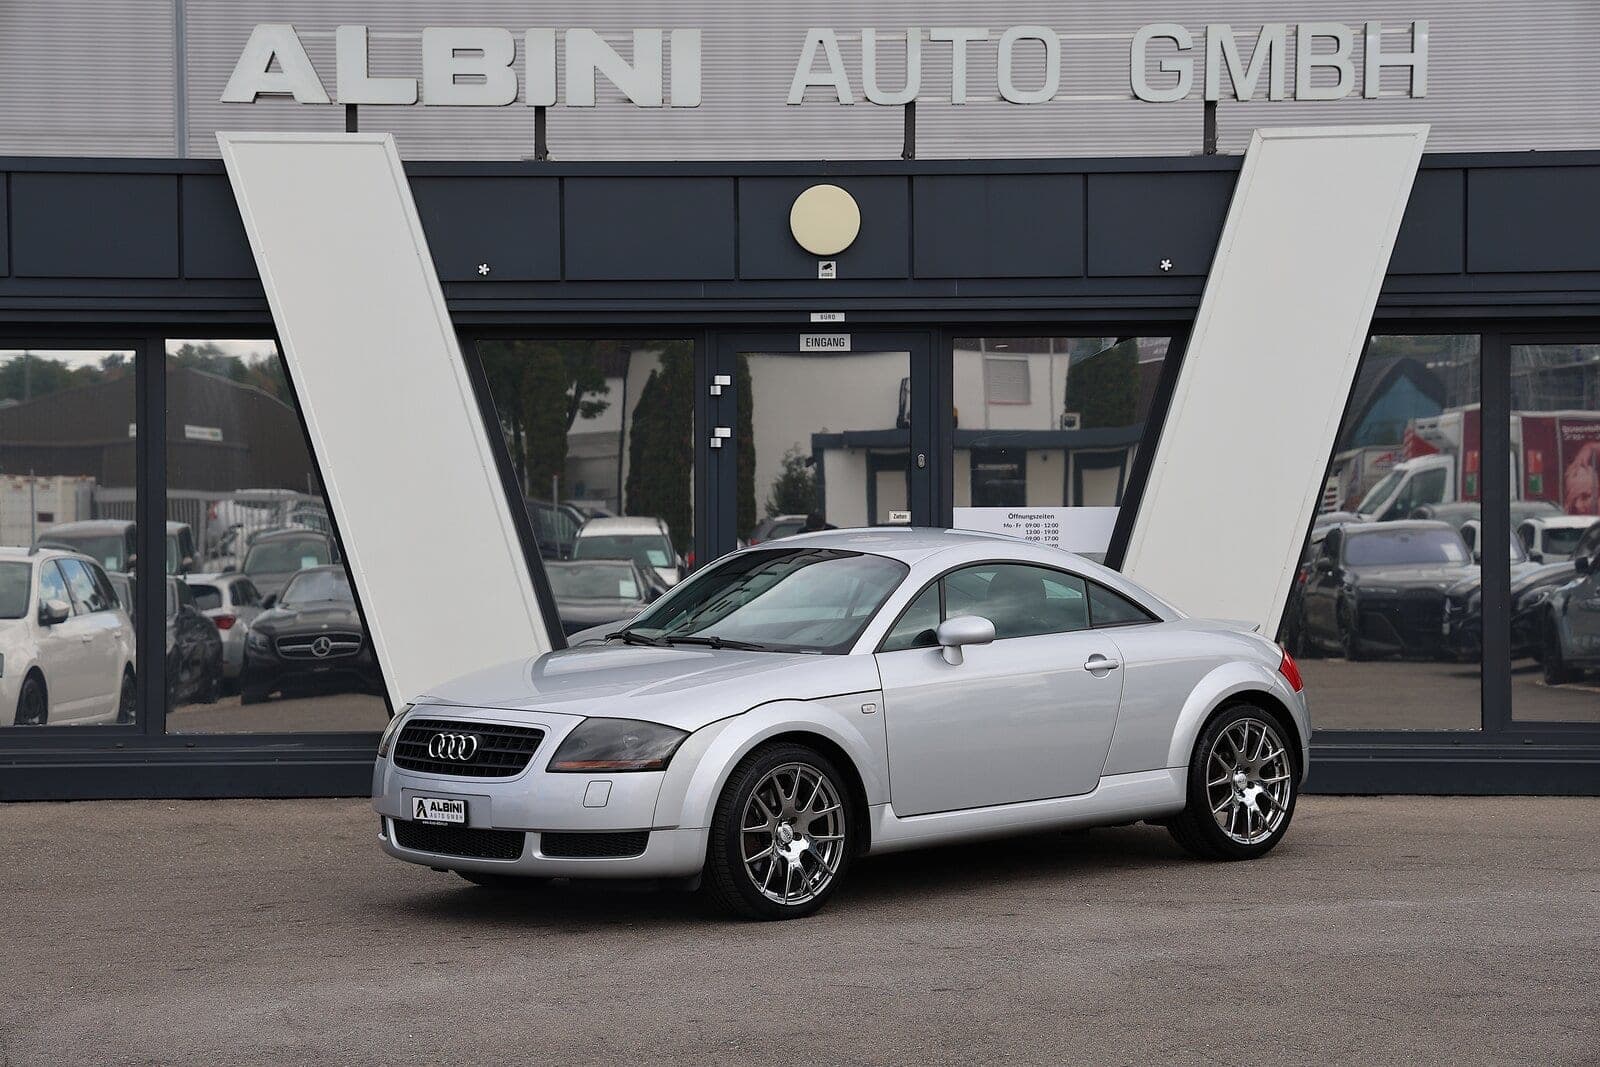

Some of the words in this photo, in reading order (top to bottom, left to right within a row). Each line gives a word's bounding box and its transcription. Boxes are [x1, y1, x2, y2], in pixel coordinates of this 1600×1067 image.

[220, 24, 702, 108] ALBINI
[786, 24, 1061, 106] AUTO
[1129, 20, 1430, 103] GMBH
[806, 337, 845, 348] EINGANG
[430, 801, 462, 813] ALBINI
